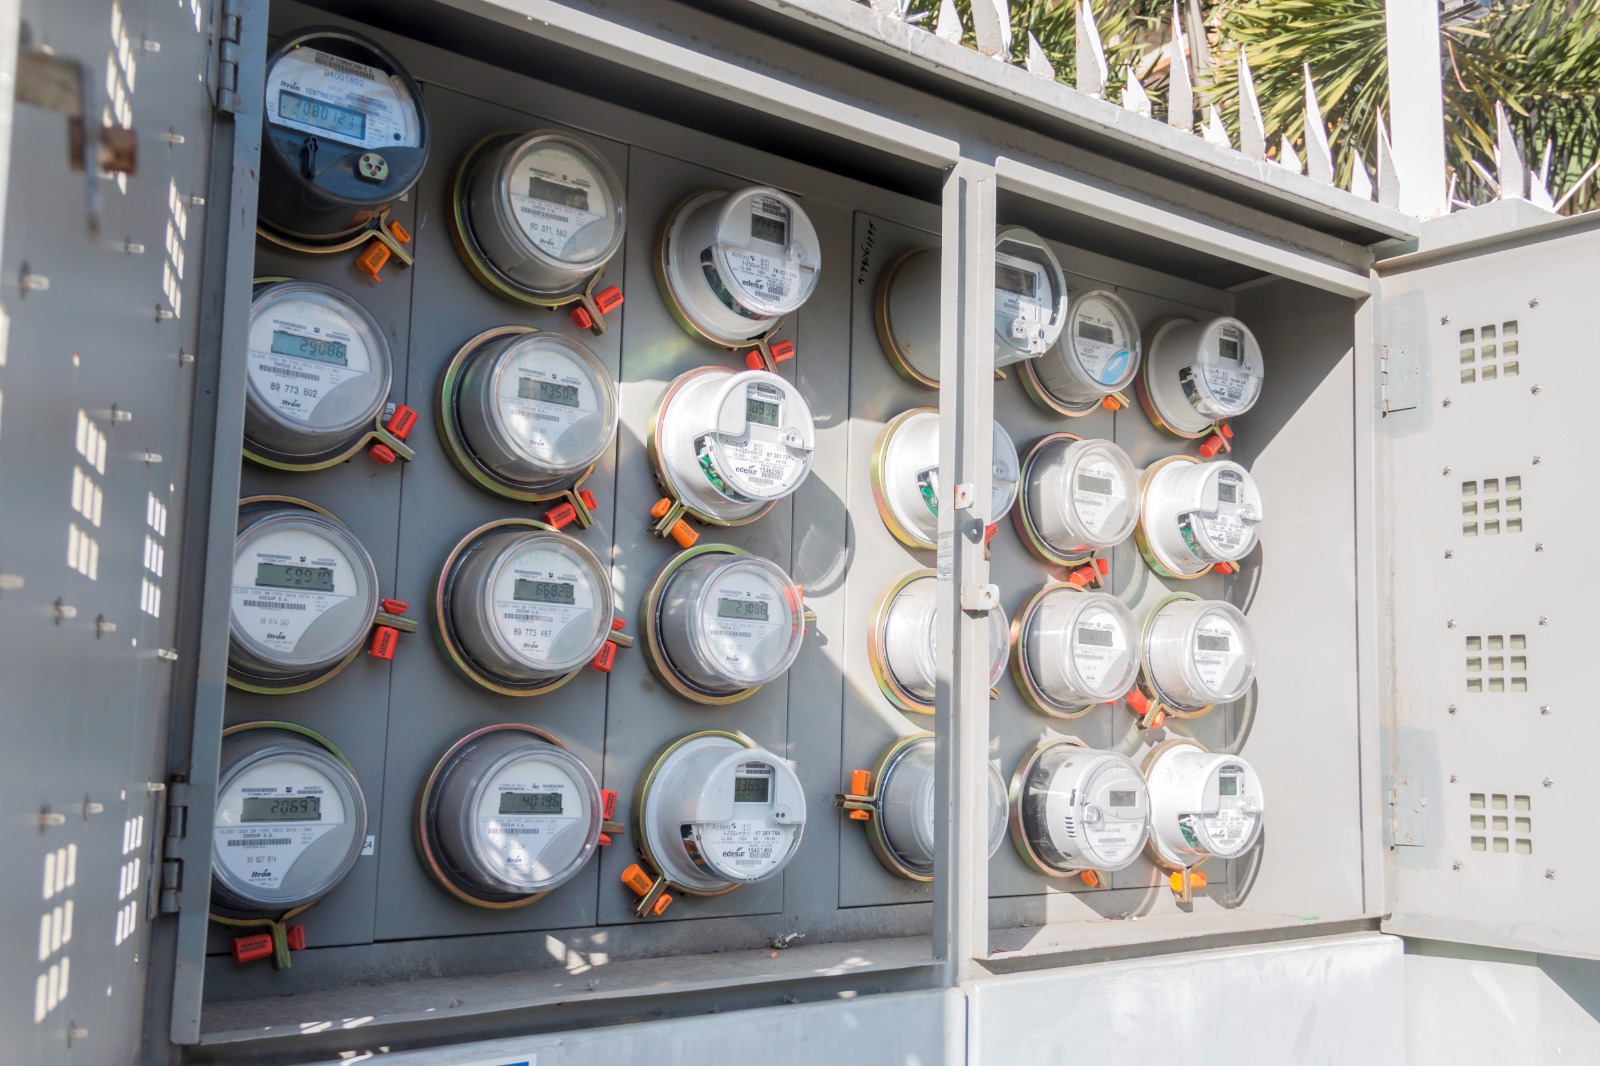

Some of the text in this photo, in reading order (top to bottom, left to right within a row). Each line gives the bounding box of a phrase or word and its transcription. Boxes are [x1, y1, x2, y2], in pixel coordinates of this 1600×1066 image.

[530, 222, 538, 230] 60
[556, 228, 568, 238] 582
[270, 382, 318, 398] 89 773 602
[514, 628, 522, 636] 89
[525, 628, 536, 636] 773
[722, 850, 746, 858] edesur
